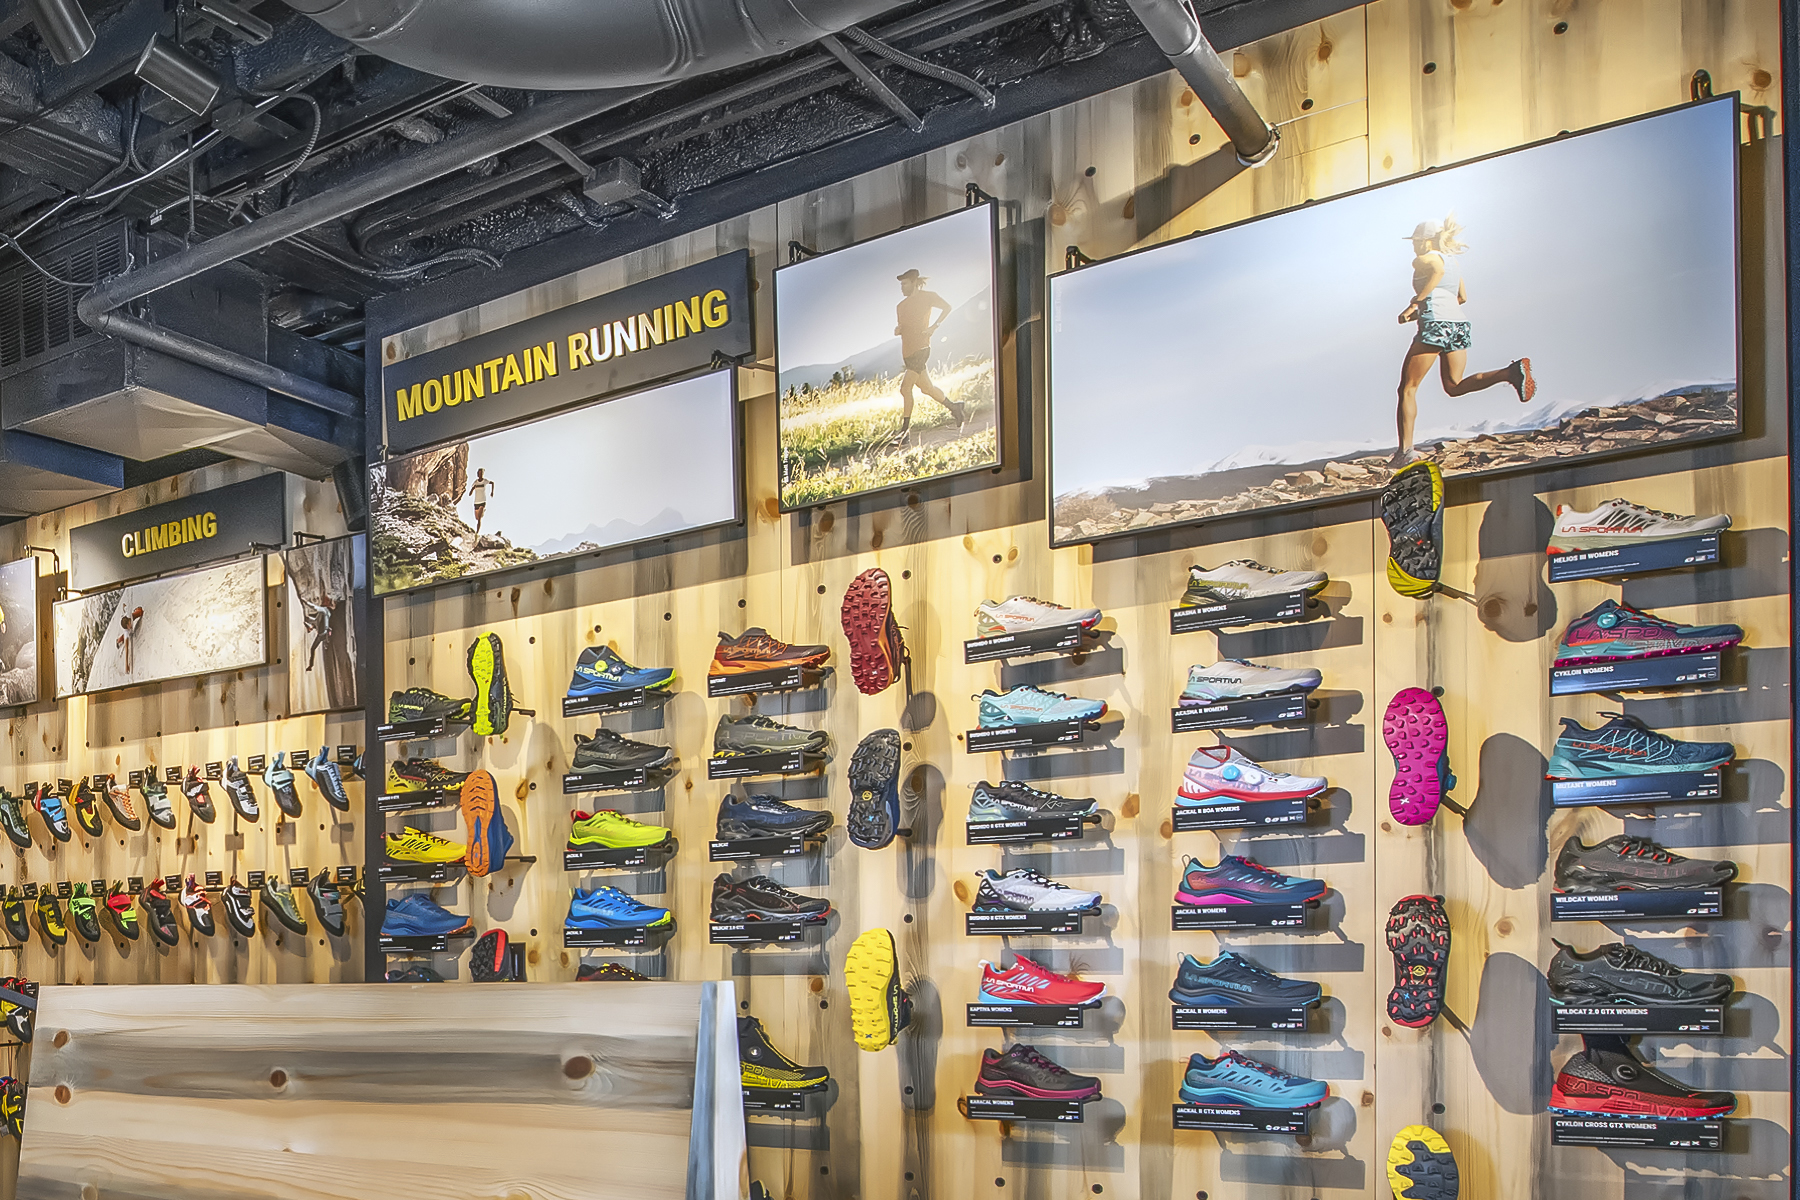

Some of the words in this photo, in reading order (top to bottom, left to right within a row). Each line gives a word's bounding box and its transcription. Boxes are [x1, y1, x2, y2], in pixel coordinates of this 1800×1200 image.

[396, 341, 558, 422] MOUNTAIN
[567, 288, 730, 372] RUNNING
[120, 511, 218, 560] CLIMBING
[1553, 555, 1578, 564] HELIOS
[1588, 550, 1620, 560] WOMENS
[1554, 669, 1582, 678] CYKLON
[1582, 666, 1614, 675] WOMENS
[1196, 676, 1242, 685] SPORTIVA
[1585, 780, 1617, 788] WOMENS
[1555, 896, 1587, 904] WILDCAT
[1587, 895, 1619, 903] WOMENS
[1557, 1008, 1588, 1016] WILDCAT
[1588, 1008, 1600, 1016] 2.0
[1600, 1008, 1616, 1016] GTX
[1616, 1008, 1649, 1016] WOMENS
[1584, 1121, 1608, 1129] CROSS
[1624, 1122, 1657, 1130] WOMENS
